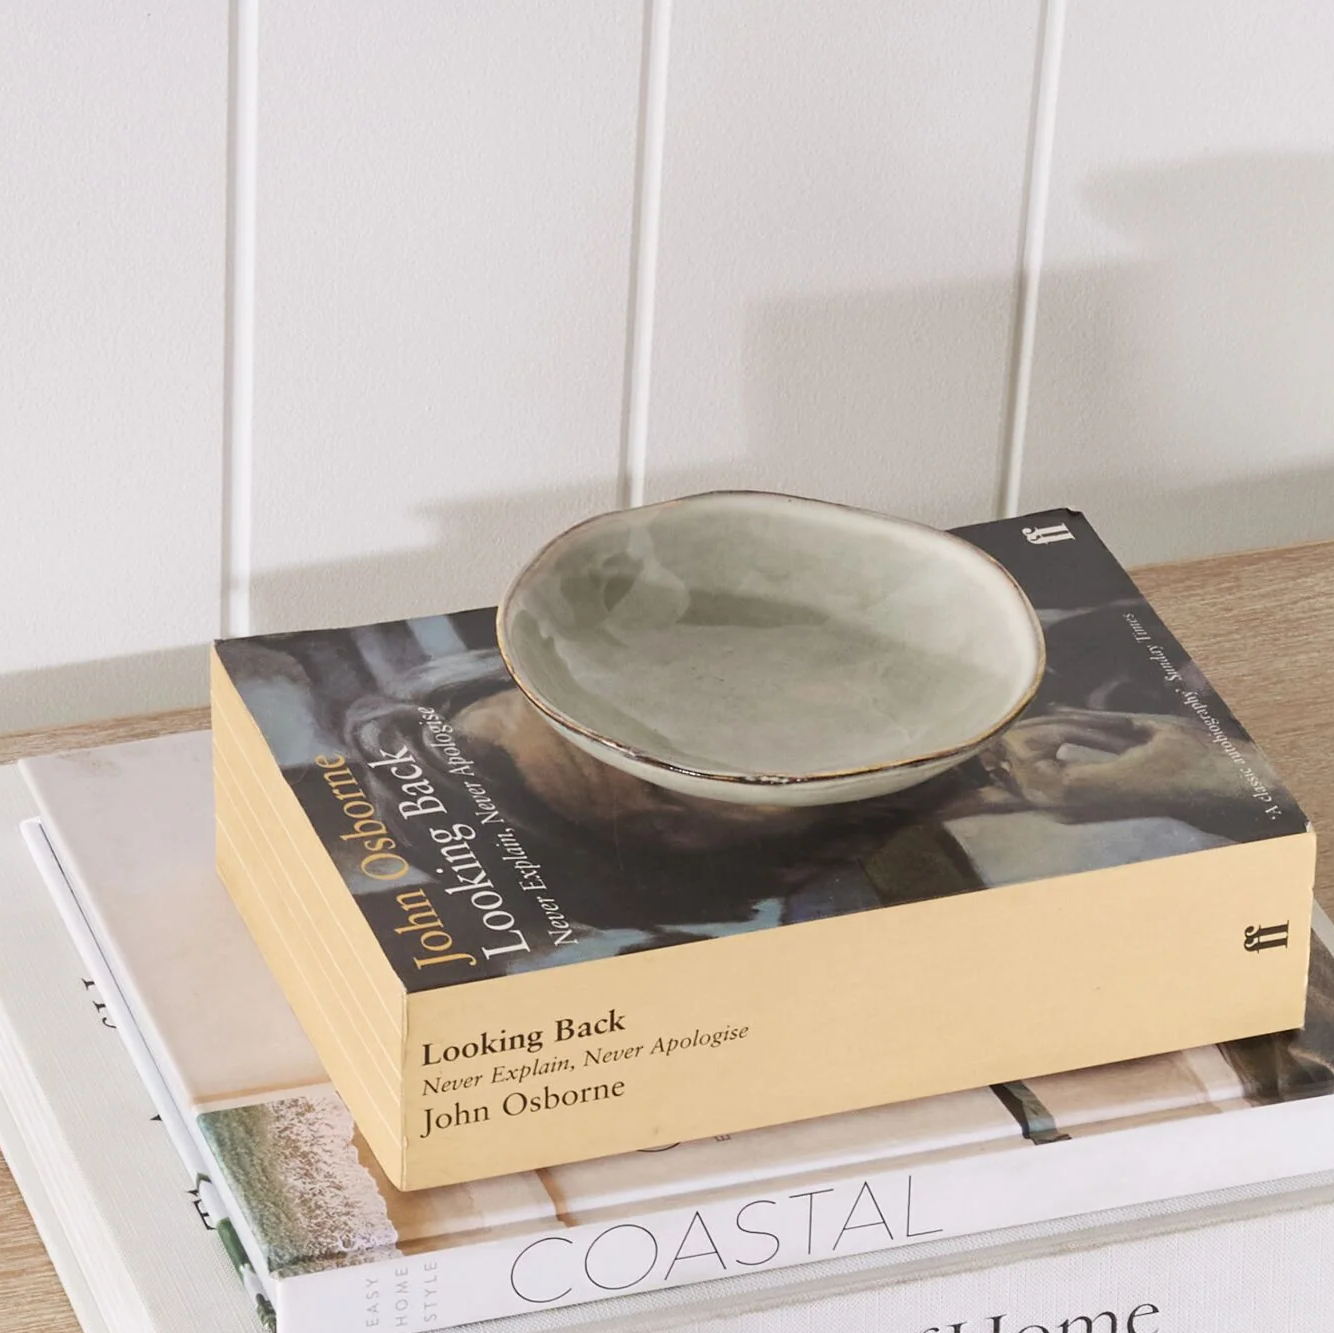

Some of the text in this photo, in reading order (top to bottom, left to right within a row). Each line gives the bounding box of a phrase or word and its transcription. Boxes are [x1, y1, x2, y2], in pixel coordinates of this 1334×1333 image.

[1122, 612, 1151, 644] Times
[1147, 644, 1183, 683] Sunday
[1239, 766, 1273, 806] classic
[368, 745, 531, 960] Looking Back
[418, 706, 579, 946] Never Explain, Never Apologise
[315, 750, 477, 970] John Osborne
[421, 1008, 627, 1068] Looking Back
[422, 1023, 750, 1097] Never Explain, Never Apologise
[420, 1078, 627, 1139] John Osborne
[510, 1174, 944, 1304] COASTAL
[365, 1277, 380, 1328] EASY
[394, 1266, 409, 1328] HOME
[423, 1260, 438, 1323] STYLE
